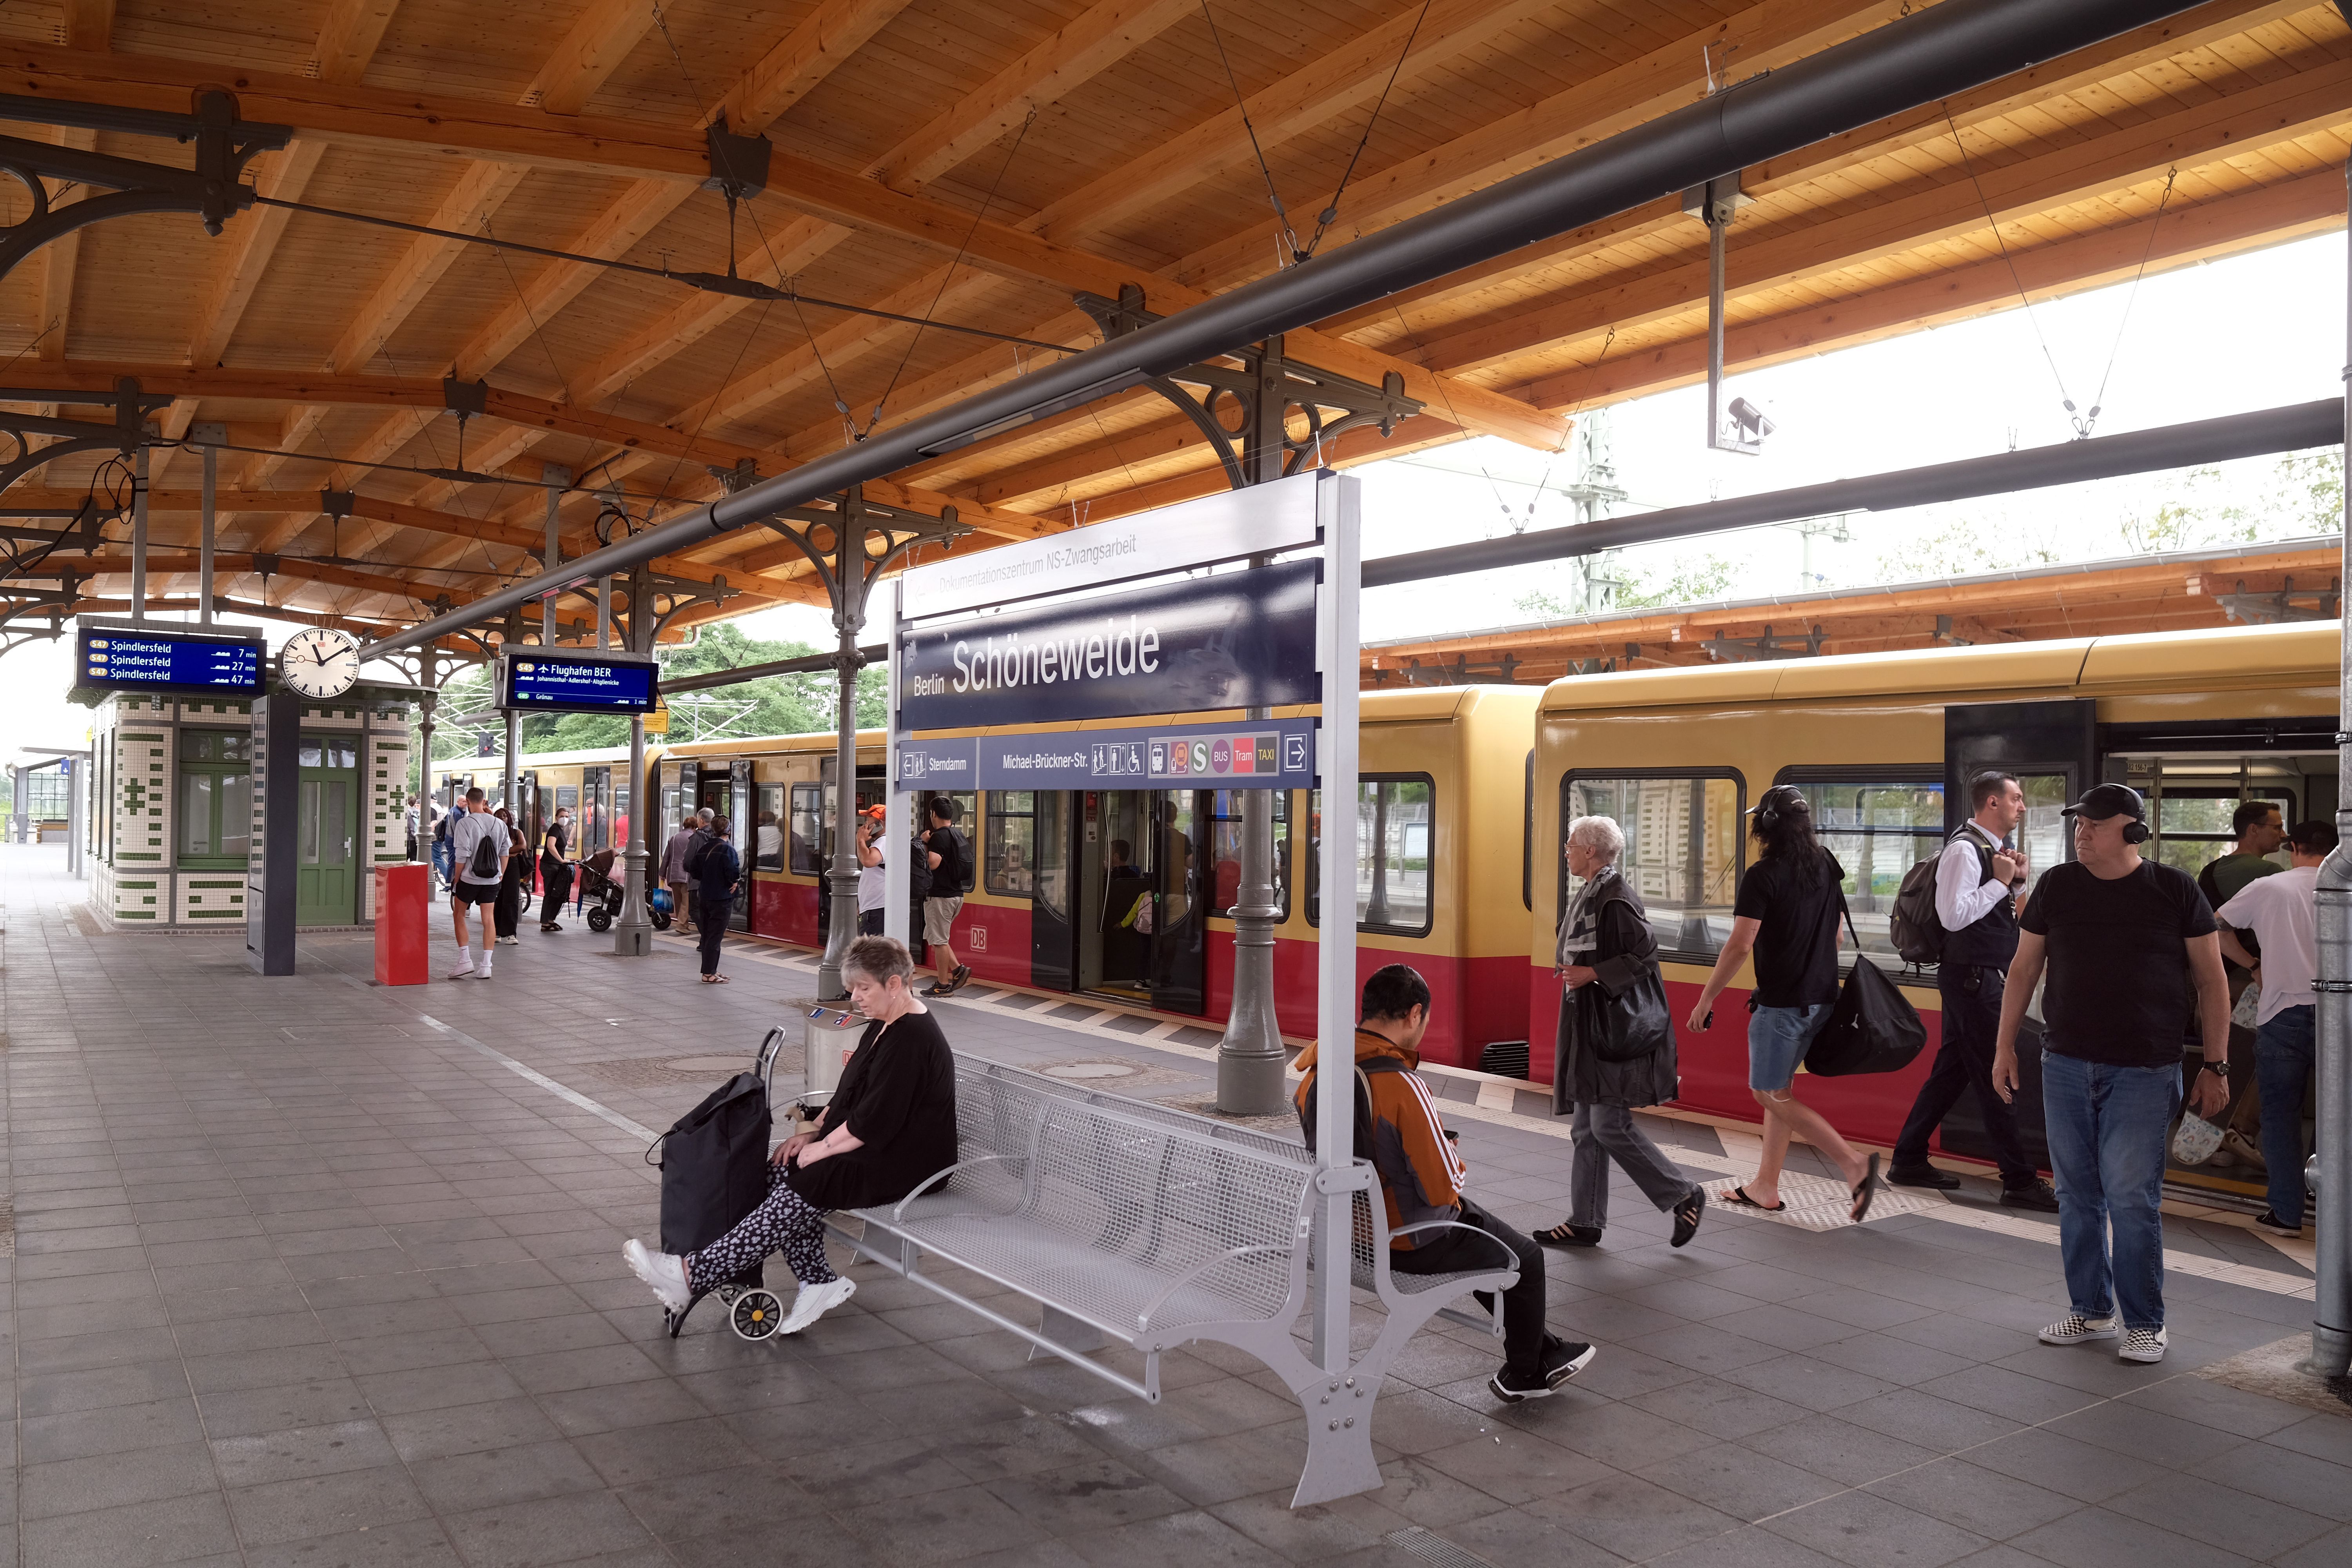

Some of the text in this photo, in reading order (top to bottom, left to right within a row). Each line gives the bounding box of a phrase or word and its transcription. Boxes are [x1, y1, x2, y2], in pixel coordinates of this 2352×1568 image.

[940, 534, 1136, 593] Dokumentationszentrum NS-Zwangsarbeit
[111, 641, 171, 653] Spindlersfeld
[238, 649, 244, 657] 7
[914, 614, 1160, 697] Berlin Schöneweide
[111, 654, 171, 667] Spindlersfeld
[232, 662, 244, 671] 27
[551, 665, 592, 677] Flughafen
[594, 667, 611, 677] BER
[110, 668, 170, 680] Spindlersfeld
[231, 675, 243, 684] 47
[929, 757, 967, 771] Sterndamm
[1003, 752, 1088, 769] Michael-Brückner-Str.
[1193, 743, 1274, 772] S BUS Tram TAXI
[972, 928, 985, 948] DB
